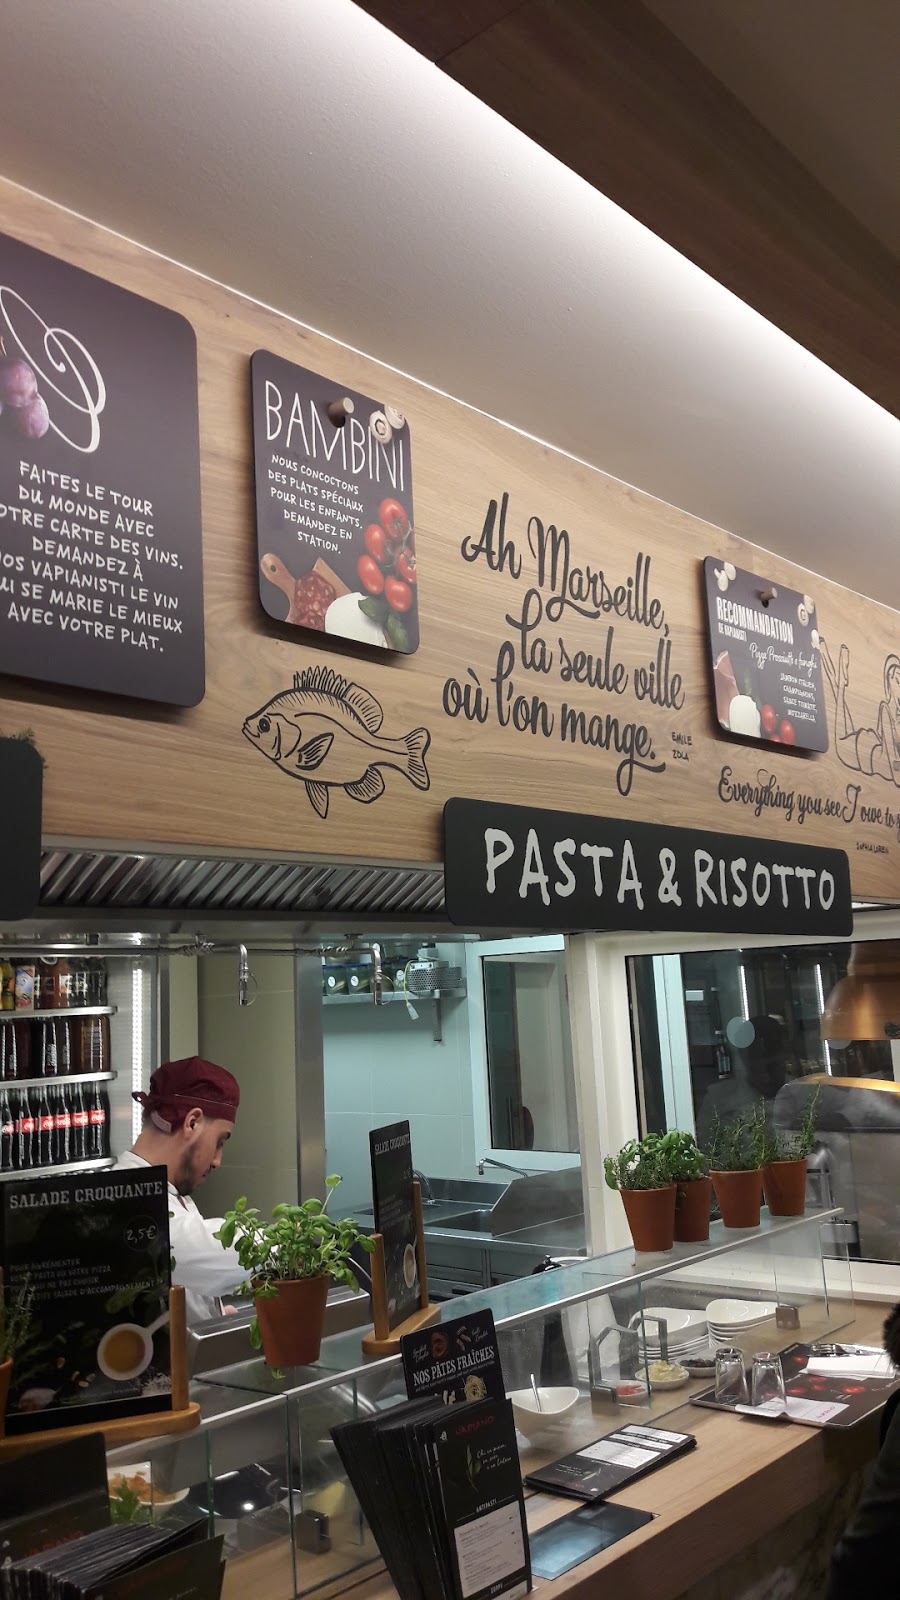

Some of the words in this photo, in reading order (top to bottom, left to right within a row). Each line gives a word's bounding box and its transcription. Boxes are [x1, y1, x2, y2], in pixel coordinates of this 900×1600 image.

[265, 380, 404, 492] BAMBINI
[19, 460, 80, 494] FAITES
[86, 482, 106, 501] LE
[110, 490, 153, 517] TOUR
[268, 469, 287, 485] DES
[290, 476, 319, 497] PLATS
[321, 489, 364, 513] SPÉCIAUX
[271, 454, 298, 472] NOUS
[300, 465, 359, 495] CONCOCTONS
[19, 484, 44, 505] DU
[49, 495, 110, 525] MONDE
[115, 513, 155, 537] AVEC
[270, 487, 297, 506] POUR
[299, 497, 316, 512] LES
[318, 505, 363, 529] ENFANTS.
[283, 508, 337, 537] DEMANDEZ
[339, 528, 353, 540] EN
[0, 503, 45, 529] OTRE
[50, 518, 105, 546] CARTE
[110, 534, 140, 556] DES
[145, 545, 184, 570] VINS.
[32, 535, 129, 576] DEMANDEZ
[133, 558, 144, 582] À
[297, 531, 342, 555] STATION.
[0, 552, 25, 572] OS
[31, 560, 125, 597] VAPIANISTI
[130, 585, 149, 602] LE
[153, 591, 179, 610] VIN
[461, 492, 522, 579] Ah
[527, 516, 670, 637] Marseille,
[8, 601, 54, 626] AVEC
[59, 615, 116, 640] VOTRE
[121, 628, 164, 653] PLAT.
[21, 581, 44, 600] SE
[49, 589, 104, 615] MARIE
[109, 602, 128, 620] LE
[132, 609, 184, 634] MIEUX
[716, 597, 794, 645] RECOMMANDATION
[558, 625, 629, 695] seule
[634, 637, 686, 711] ville
[443, 667, 489, 724] où
[561, 703, 667, 797] mange.
[671, 731, 693, 746] EMILE
[718, 765, 796, 822] Everything
[797, 792, 824, 824] you
[823, 797, 842, 819] see
[860, 805, 884, 824] owe
[885, 806, 896, 828] to
[484, 827, 645, 911] PASTA
[658, 847, 683, 907] &
[693, 848, 836, 911] RISOTTO
[9, 1188, 70, 1210] SALADE
[74, 1180, 164, 1204] CROQUANTE
[413, 1367, 431, 1386] NOS
[431, 1359, 457, 1380] PÂTES
[457, 1345, 495, 1371] FRAÎCHES
